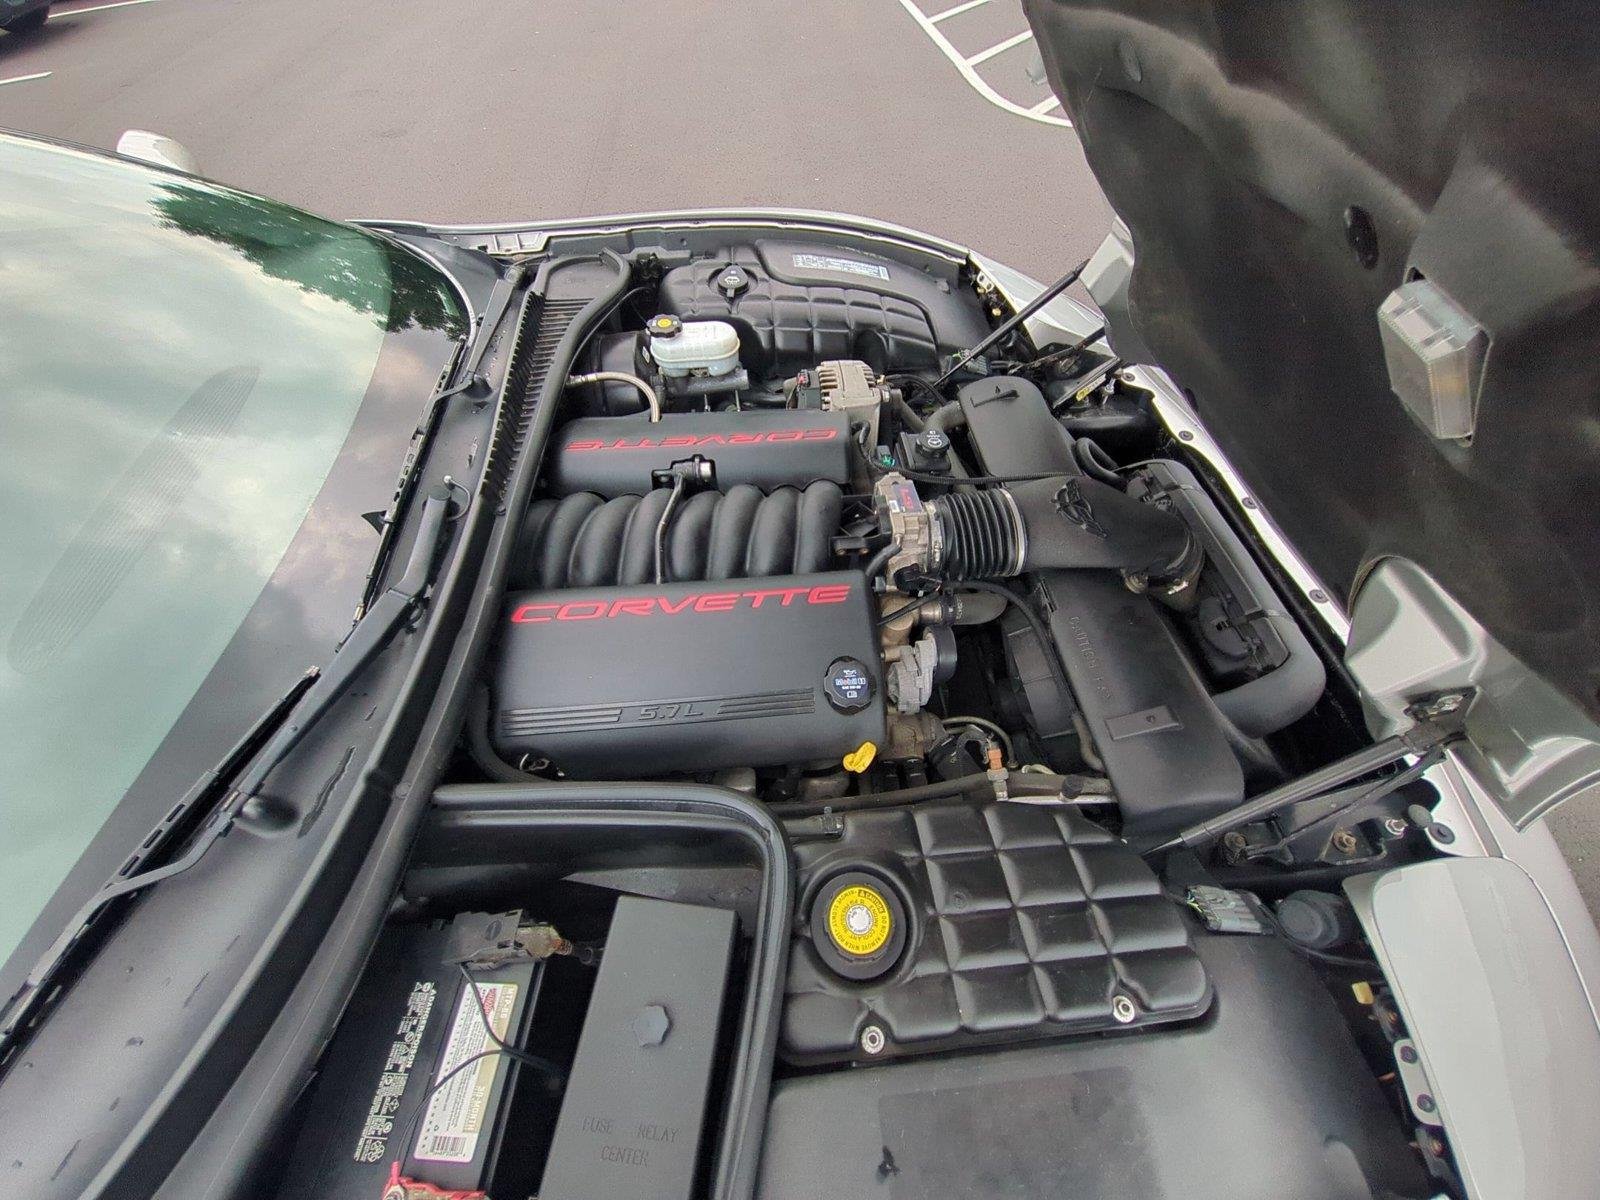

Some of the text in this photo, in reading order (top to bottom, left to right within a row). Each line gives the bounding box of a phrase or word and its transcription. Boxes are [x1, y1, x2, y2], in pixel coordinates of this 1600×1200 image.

[564, 428, 838, 452] CORVETTE
[510, 584, 852, 625] CORVETTE
[637, 703, 705, 721] 5.7L
